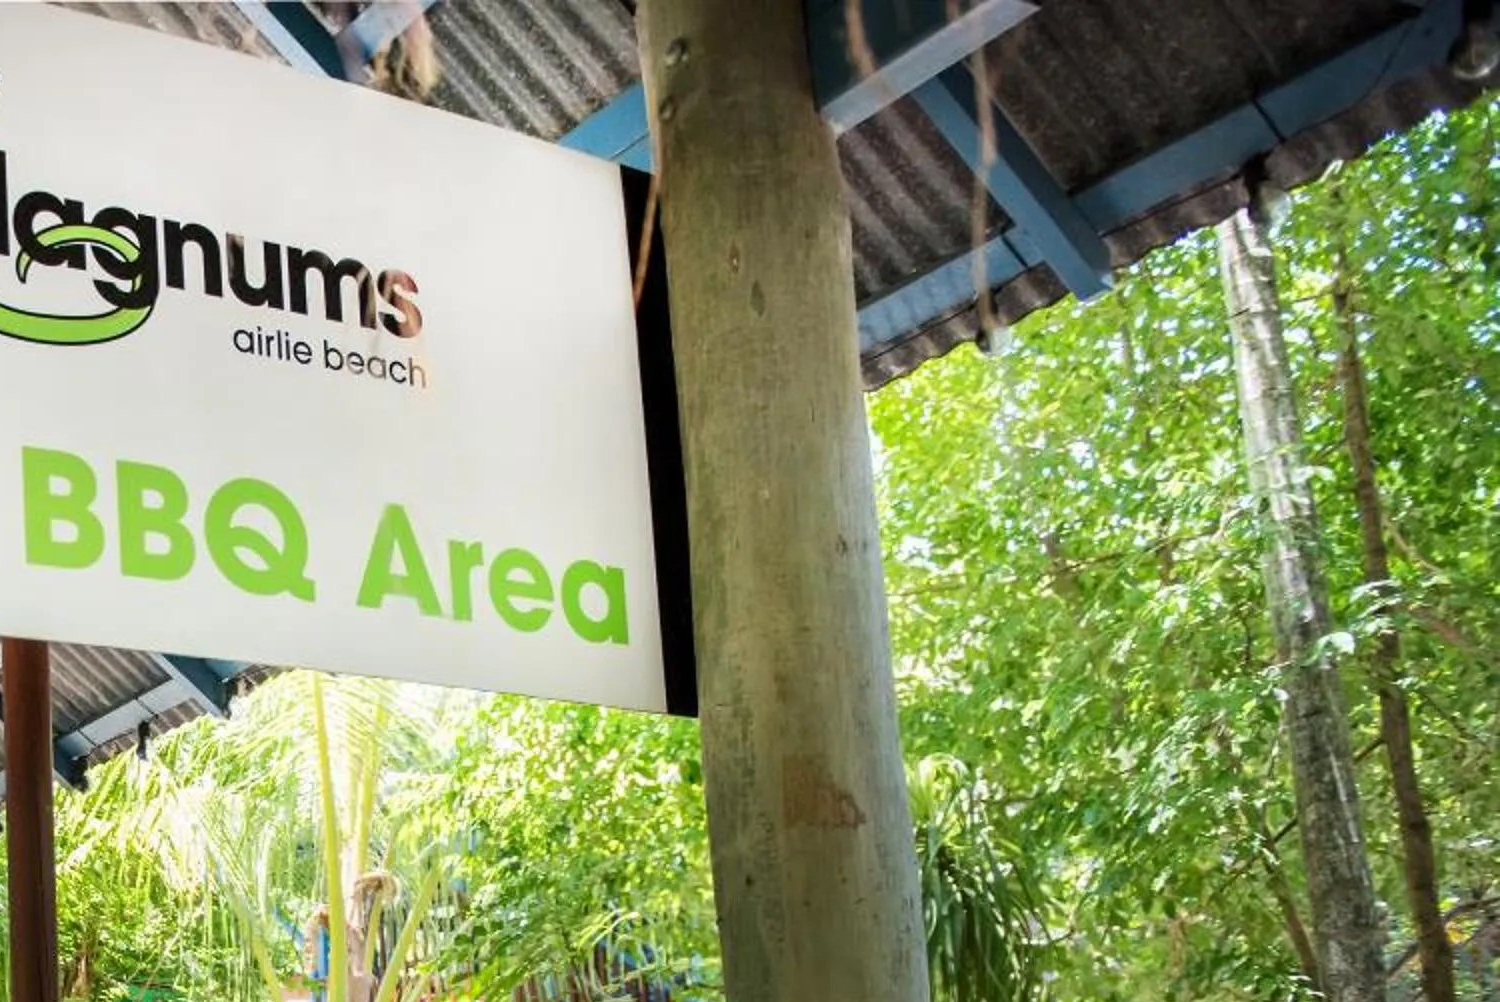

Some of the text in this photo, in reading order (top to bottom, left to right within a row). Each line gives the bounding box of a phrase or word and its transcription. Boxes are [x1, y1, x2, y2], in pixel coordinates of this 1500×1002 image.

[232, 325, 427, 389] airlie beach
[20, 445, 316, 603] BBQ
[355, 502, 630, 647] Area
